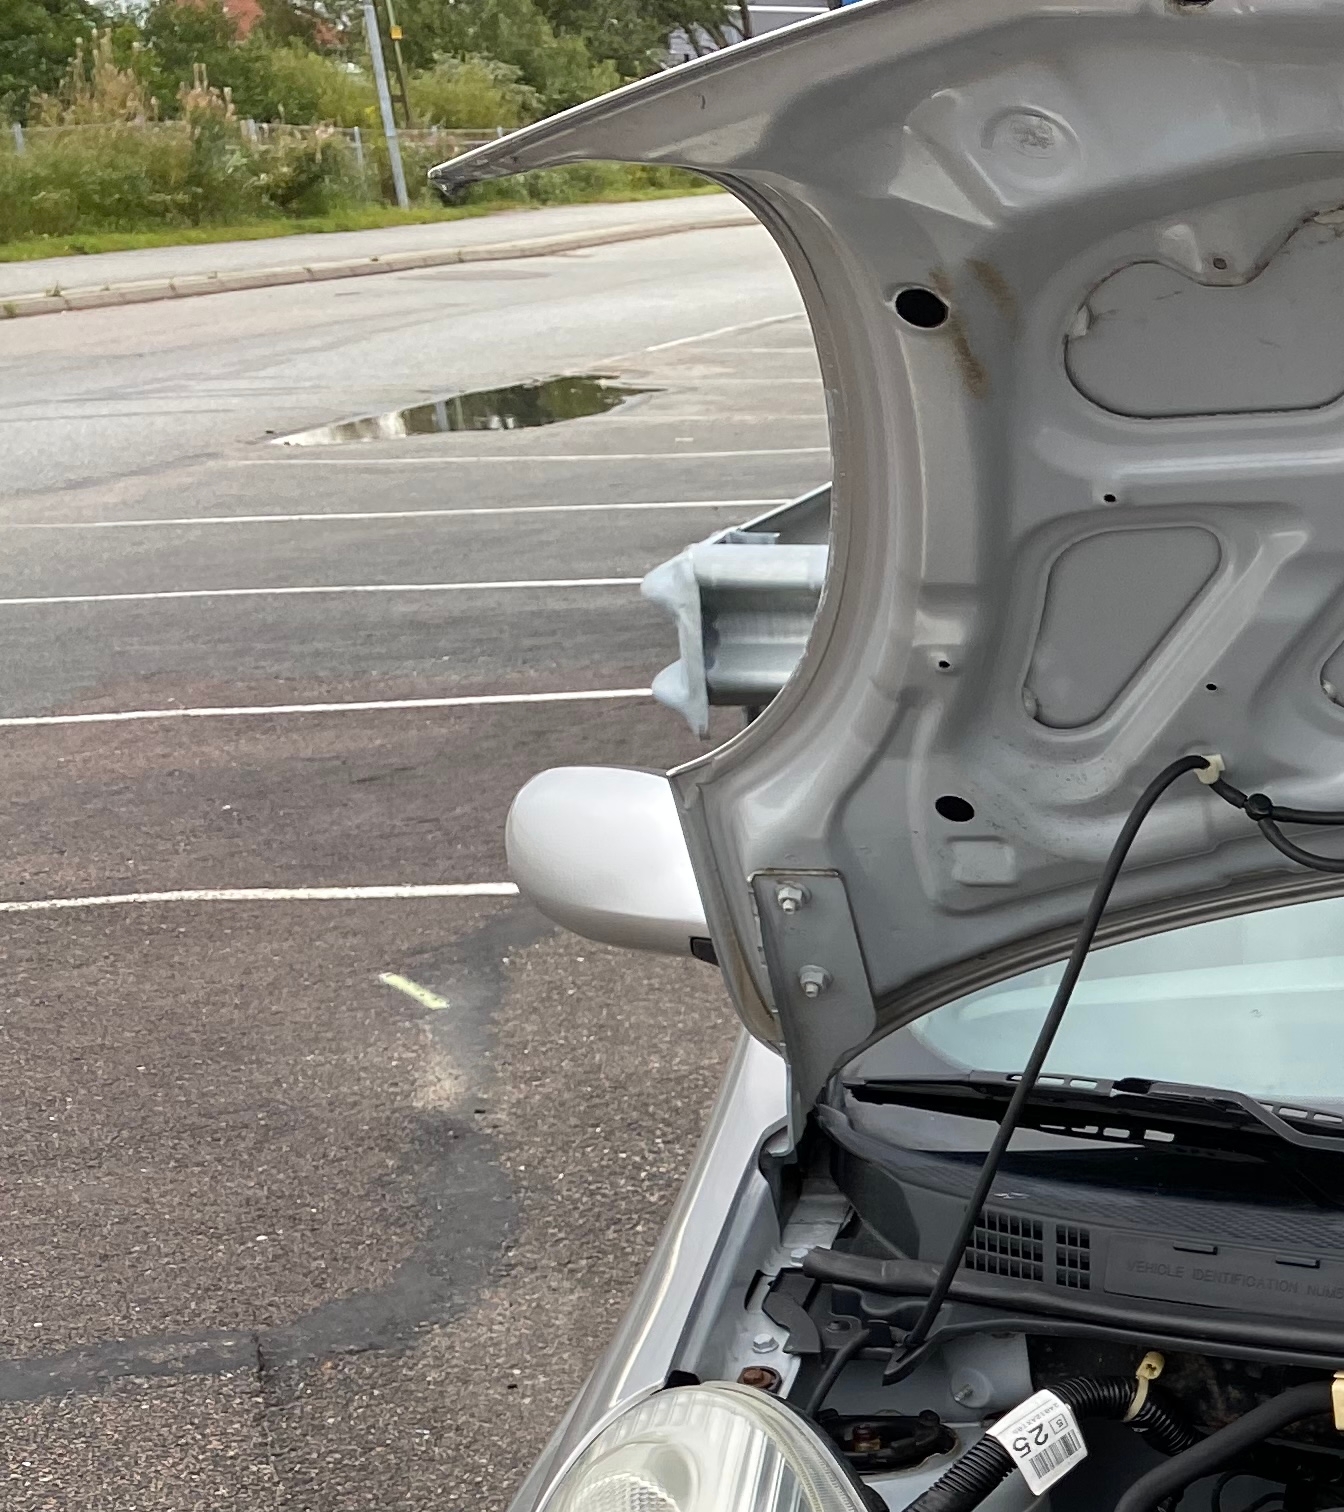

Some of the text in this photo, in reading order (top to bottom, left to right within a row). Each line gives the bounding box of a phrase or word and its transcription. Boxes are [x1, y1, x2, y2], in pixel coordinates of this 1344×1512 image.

[1127, 1260, 1185, 1279] VEHICLE
[1191, 1267, 1299, 1294] IDENTIFICATION
[1012, 1423, 1049, 1459] 25
